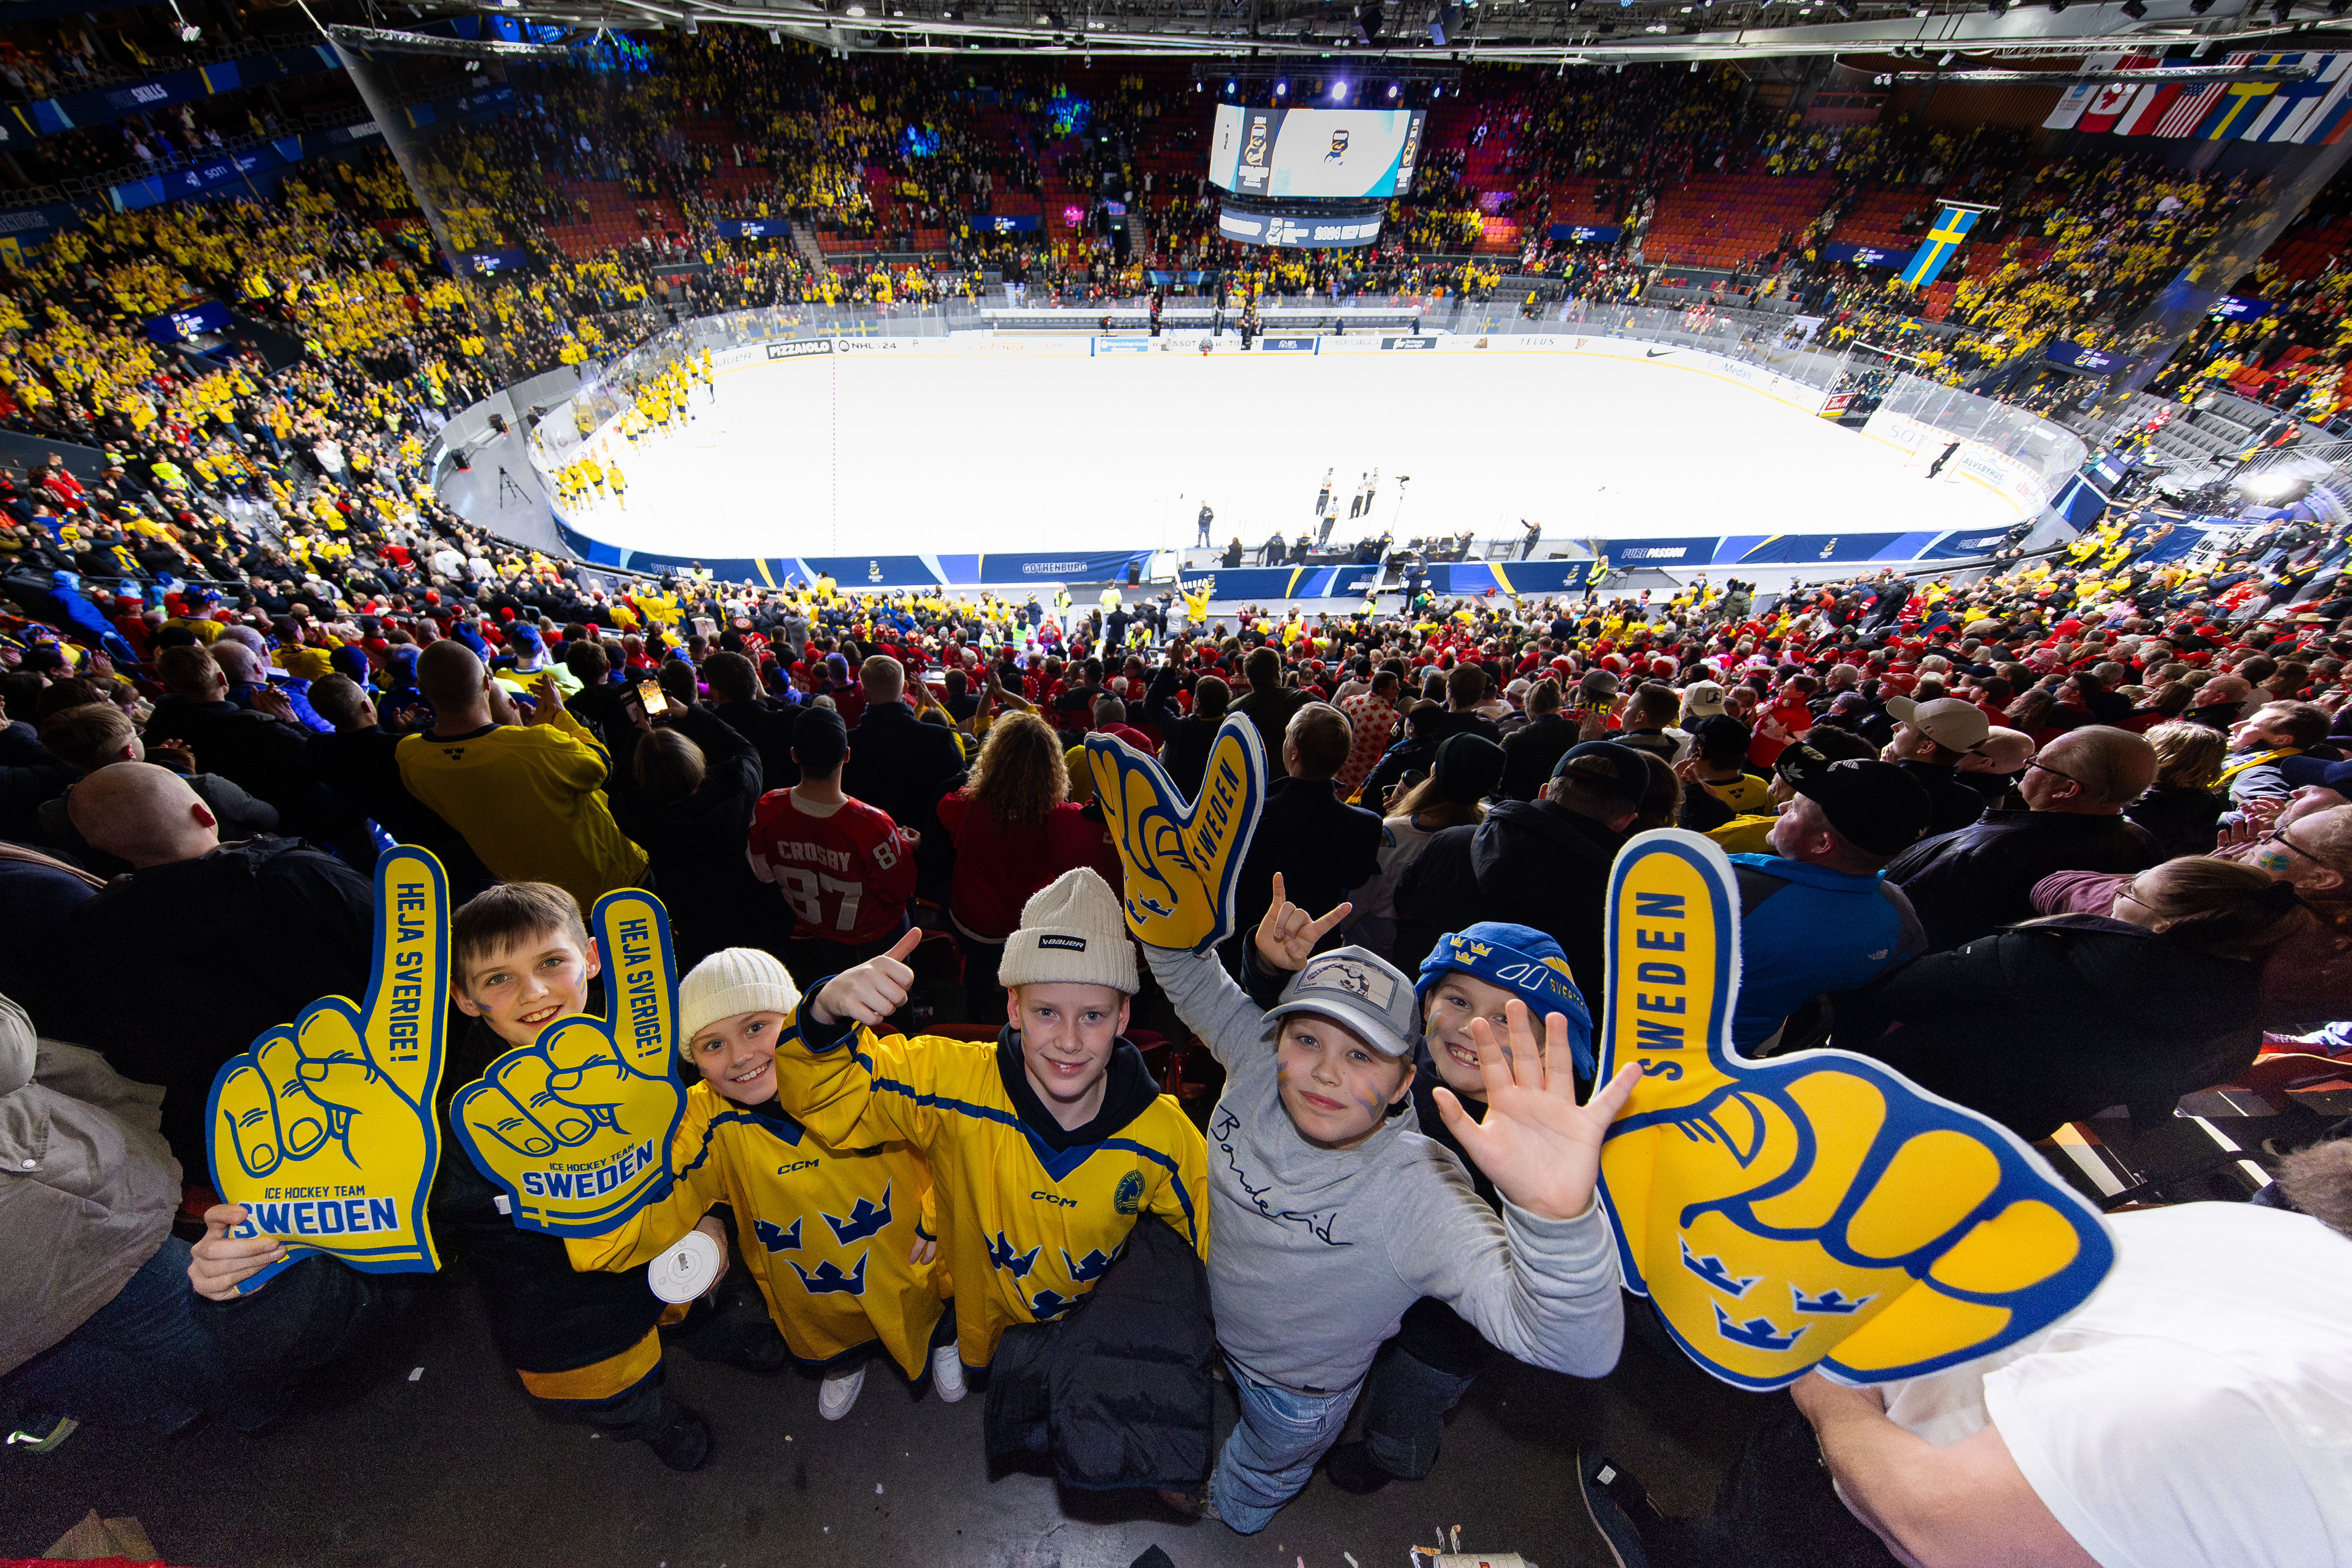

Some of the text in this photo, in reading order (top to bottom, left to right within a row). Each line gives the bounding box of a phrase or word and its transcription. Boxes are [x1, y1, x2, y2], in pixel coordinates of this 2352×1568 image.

[131, 83, 168, 103] SKILLS
[204, 166, 228, 179] SOTI
[769, 341, 830, 357] PIZZAIOLO
[1722, 362, 1752, 379] Medals
[1621, 547, 1687, 559] PURE PASSION
[1022, 562, 1088, 574] GOTHENBURG
[1781, 764, 1793, 783] adidas
[1194, 755, 1240, 872] SWEDEN
[777, 840, 851, 872] CROSBY
[871, 828, 901, 870] 87
[773, 864, 863, 931] 87
[1048, 938, 1085, 949] BAUER
[389, 882, 425, 1062] HEJA SVERIGE!
[618, 918, 663, 1058] HEJA SVERIGE!
[1637, 891, 1687, 1082] SWEDEN
[549, 1143, 636, 1172] ICE HOCKEY TEAM
[777, 1158, 820, 1175] CCM
[521, 1137, 655, 1200] SWEDEN
[264, 1185, 366, 1199] ICE HOCKEY TEAM
[1031, 1191, 1078, 1208] CCM
[225, 1197, 400, 1239] SWEDEN
